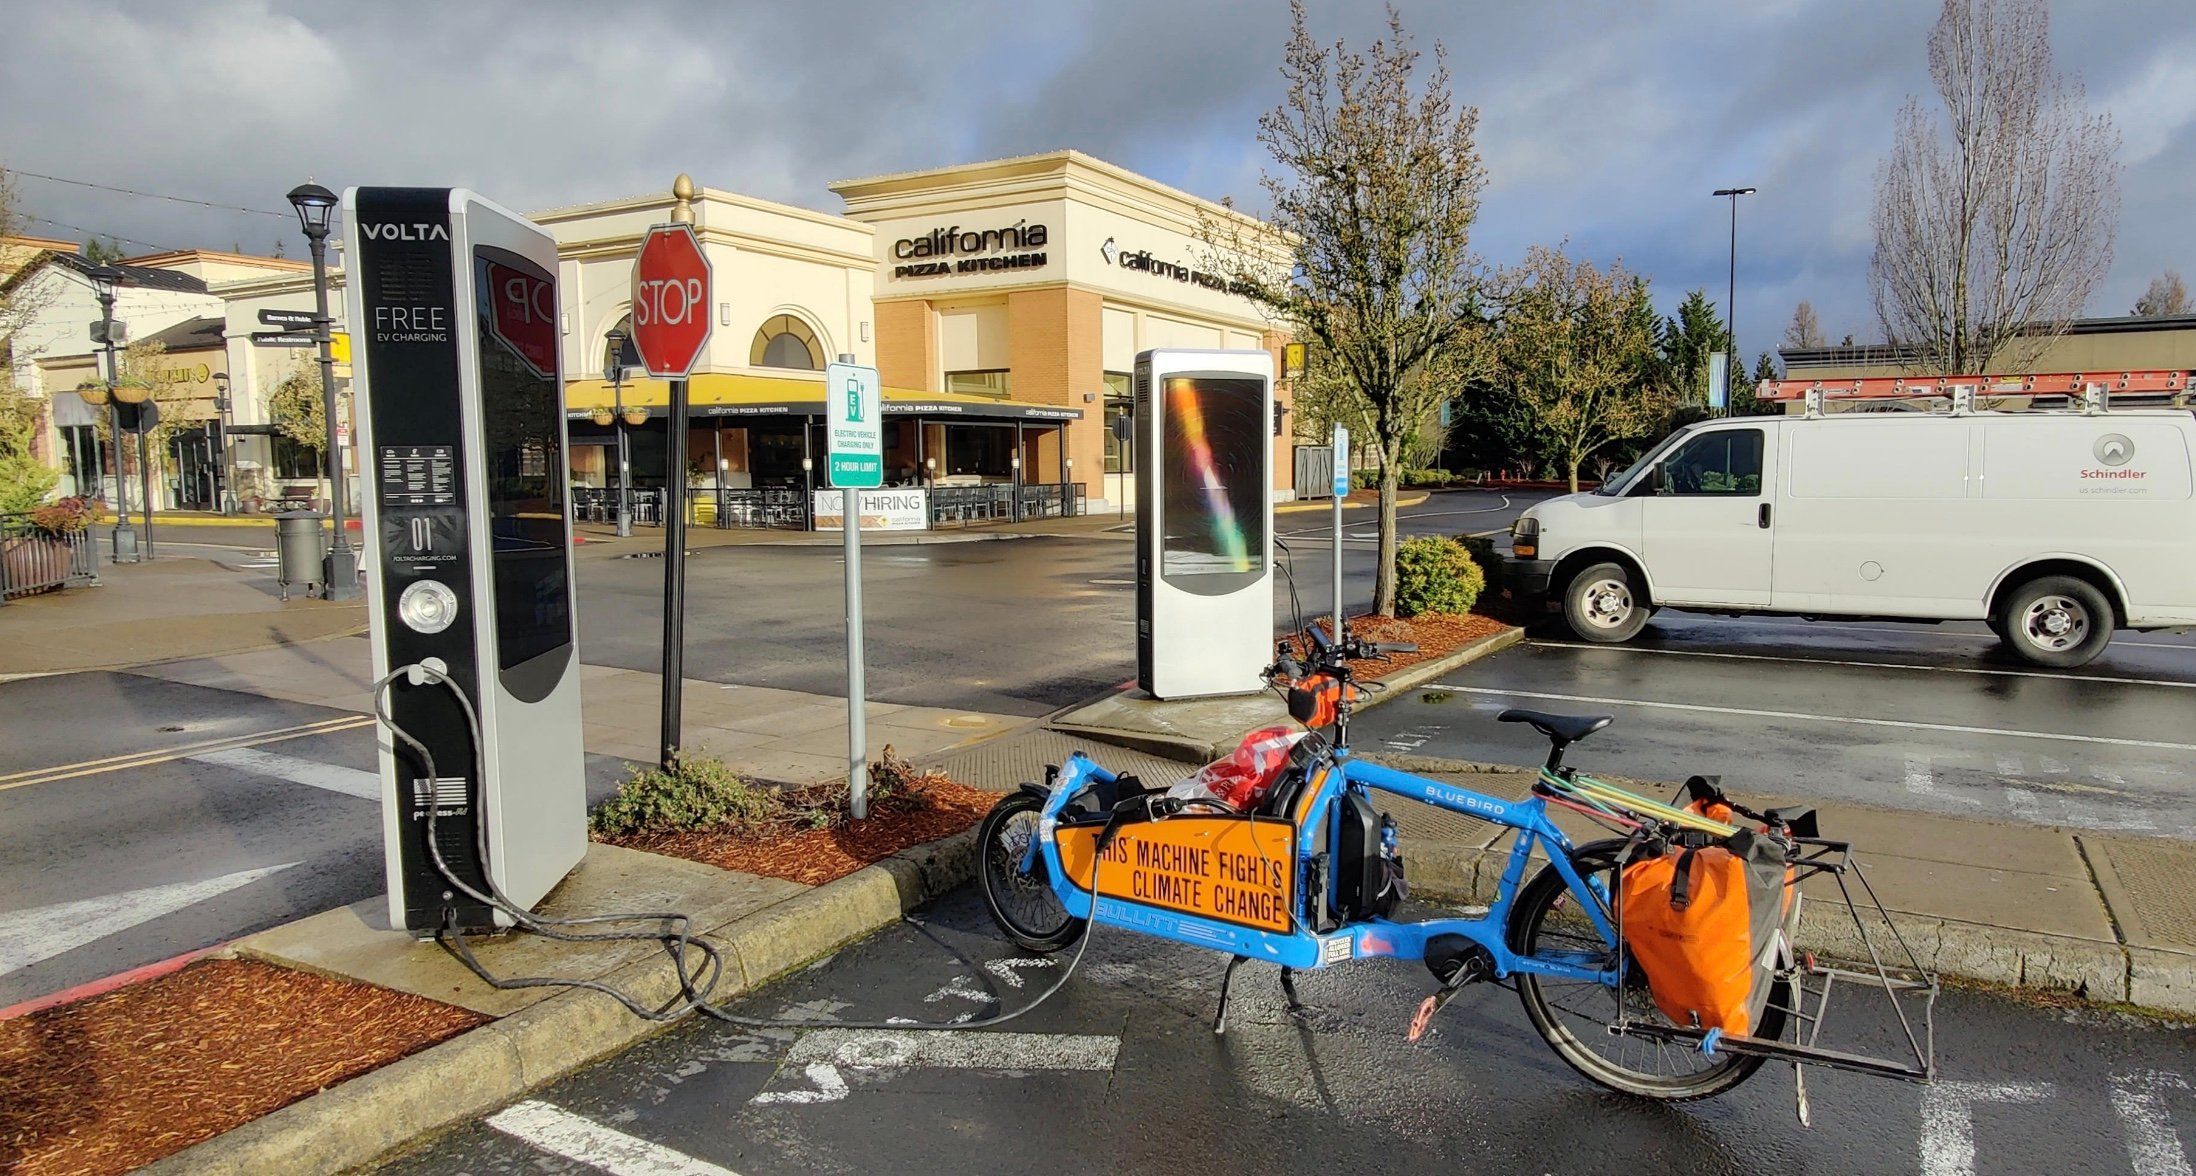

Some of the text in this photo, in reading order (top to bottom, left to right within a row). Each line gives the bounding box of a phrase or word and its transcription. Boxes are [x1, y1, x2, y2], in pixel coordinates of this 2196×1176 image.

[360, 223, 450, 241] VOLTA
[894, 218, 1048, 259] california
[895, 252, 1047, 278] PIZZA KITCHEN
[1118, 249, 1189, 283] california
[637, 278, 703, 326] STOP
[375, 306, 447, 330] FREE
[376, 333, 447, 342] EV CHARGING
[708, 407, 739, 415] california
[834, 429, 877, 440] ELECTRIC VEHICLE
[837, 440, 874, 450] CHARGING ONLY
[834, 461, 878, 473] 2 HOUR LIMIT
[2080, 469, 2147, 479] Schindler
[864, 495, 920, 511] HIRING
[411, 517, 432, 551] 01
[1425, 785, 1505, 815] BLUEBIRD
[1136, 839, 1210, 877] MACHINE
[1219, 851, 1283, 889] FIGHTS
[1132, 869, 1202, 908] CLIMATE
[1214, 883, 1283, 924] CHANGE
[1096, 903, 1178, 931] BULLITT
